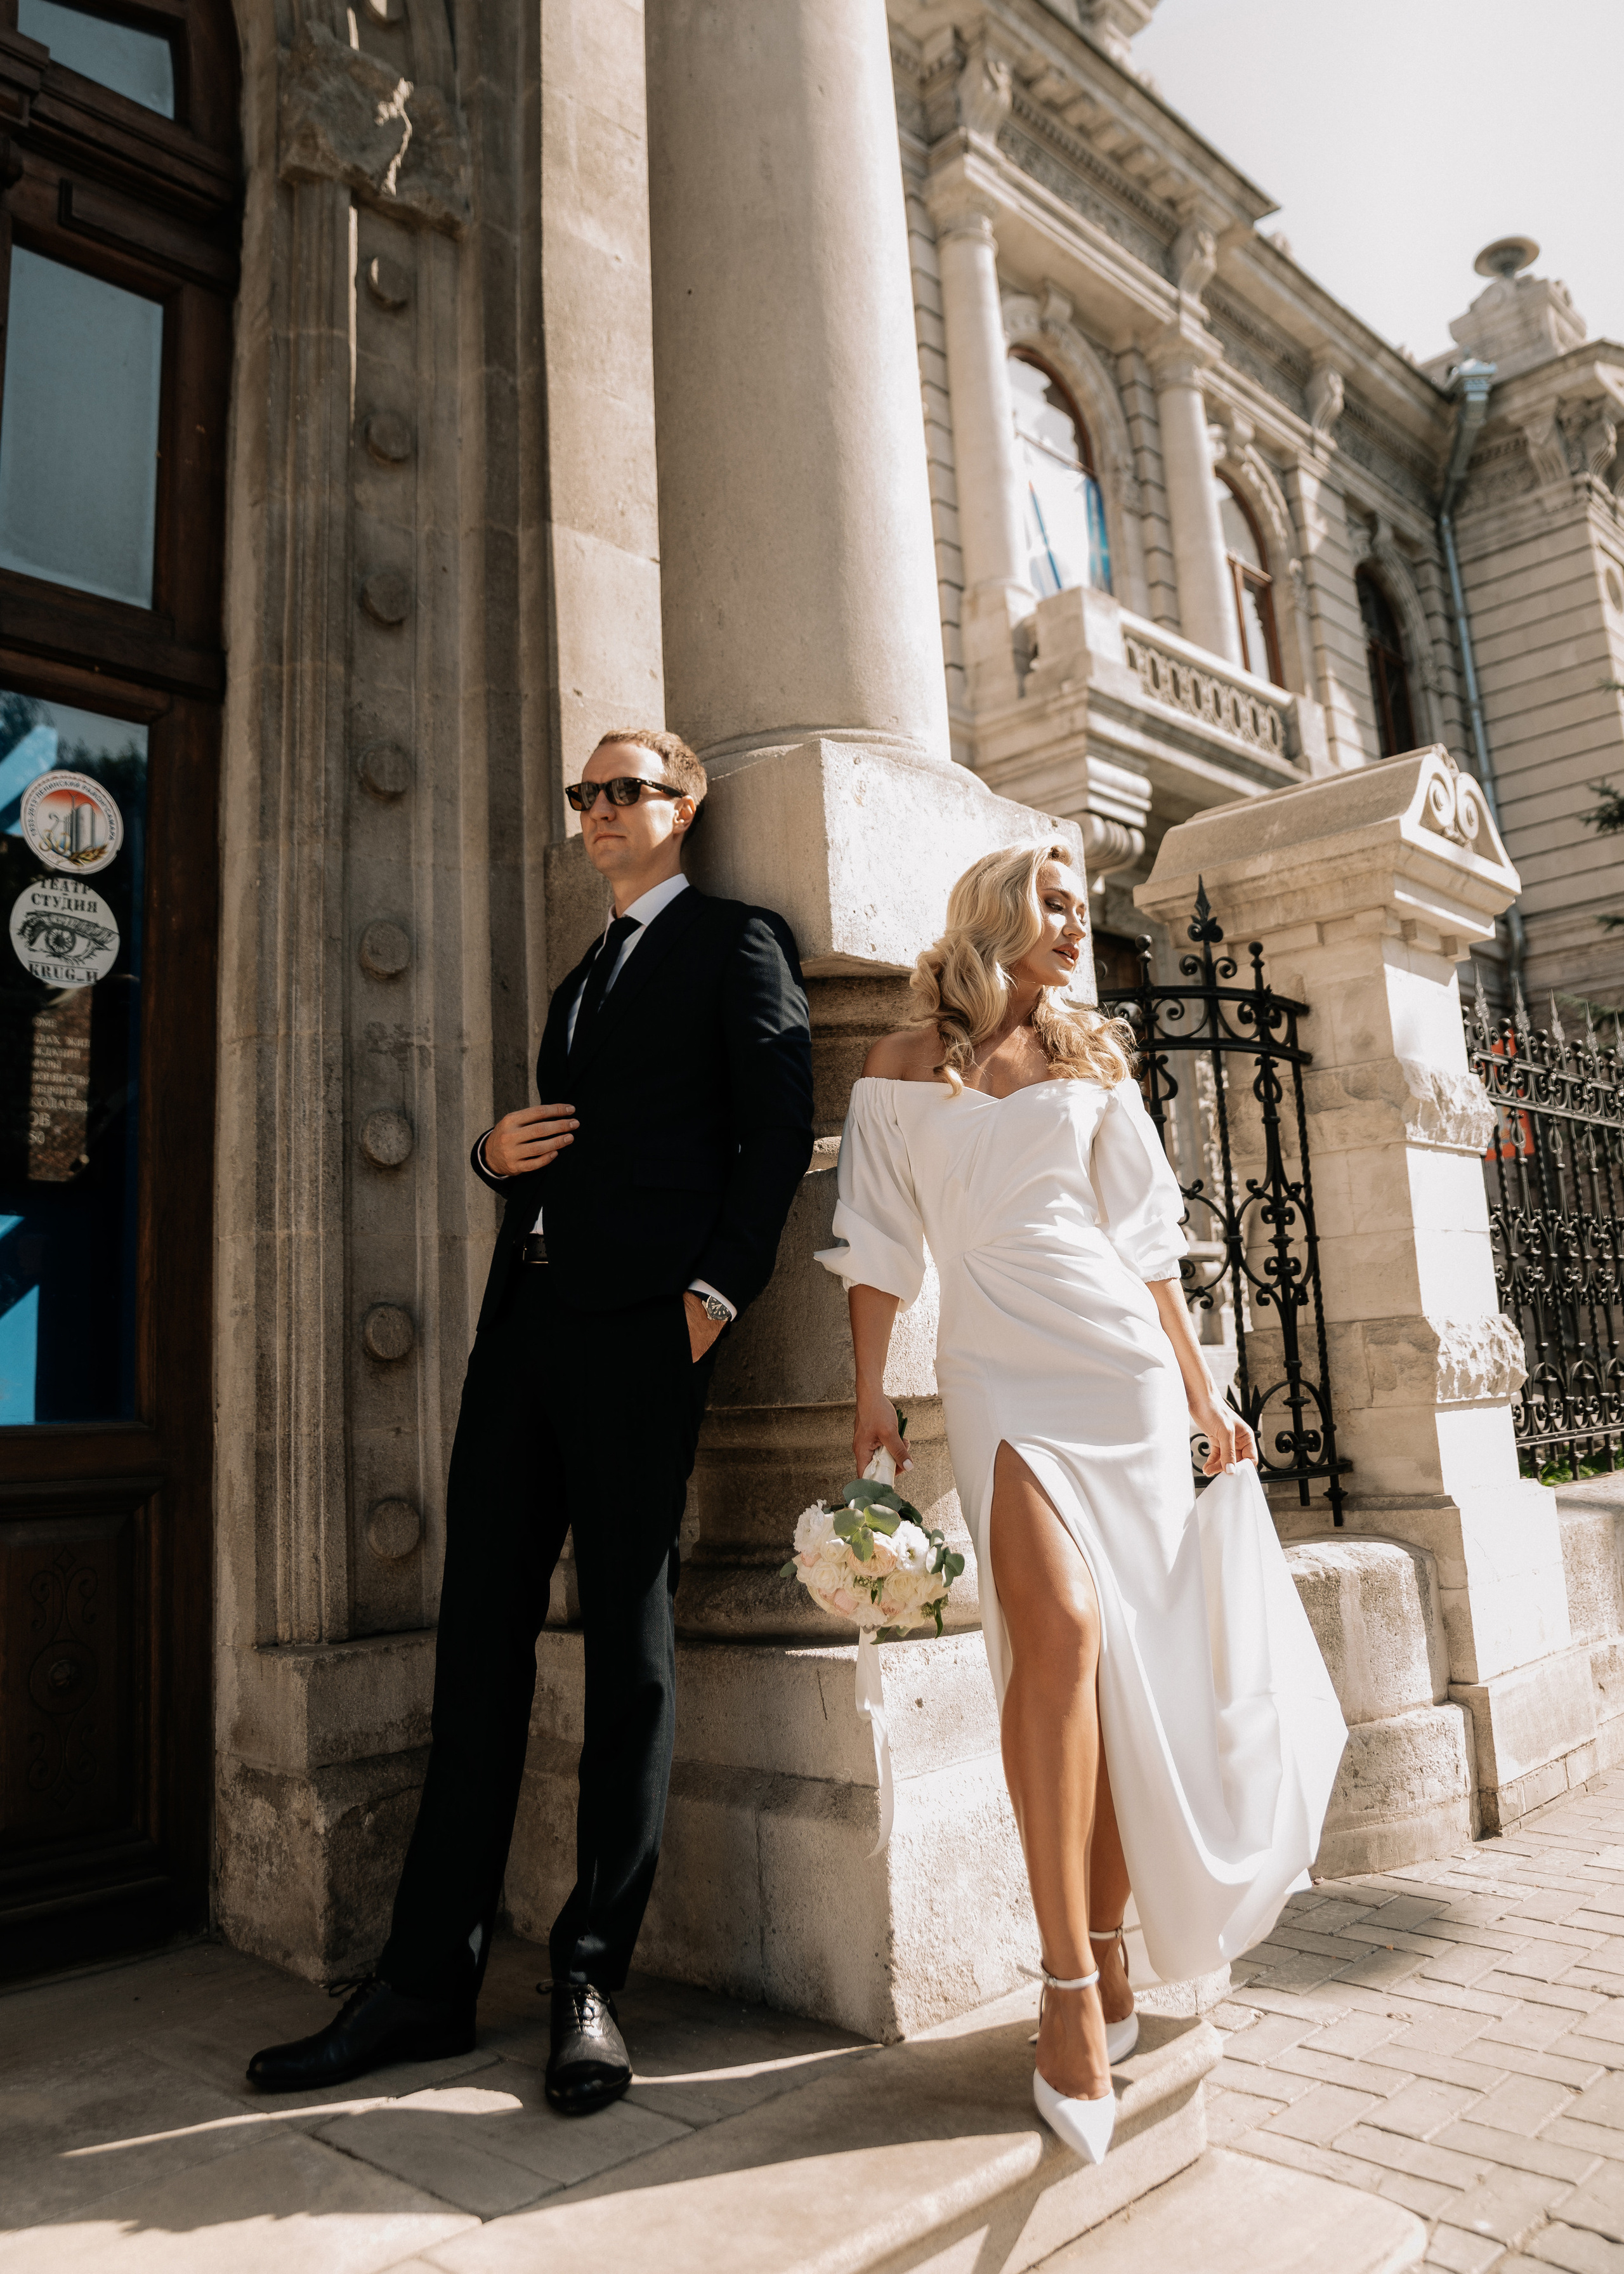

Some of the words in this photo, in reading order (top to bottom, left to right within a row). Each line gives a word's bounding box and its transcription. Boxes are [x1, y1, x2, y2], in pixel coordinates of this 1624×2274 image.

[36, 780, 81, 799] ЛЕНИНСКИЙ
[104, 807, 116, 841] САМАРА
[31, 892, 98, 913] СТУДИЯ
